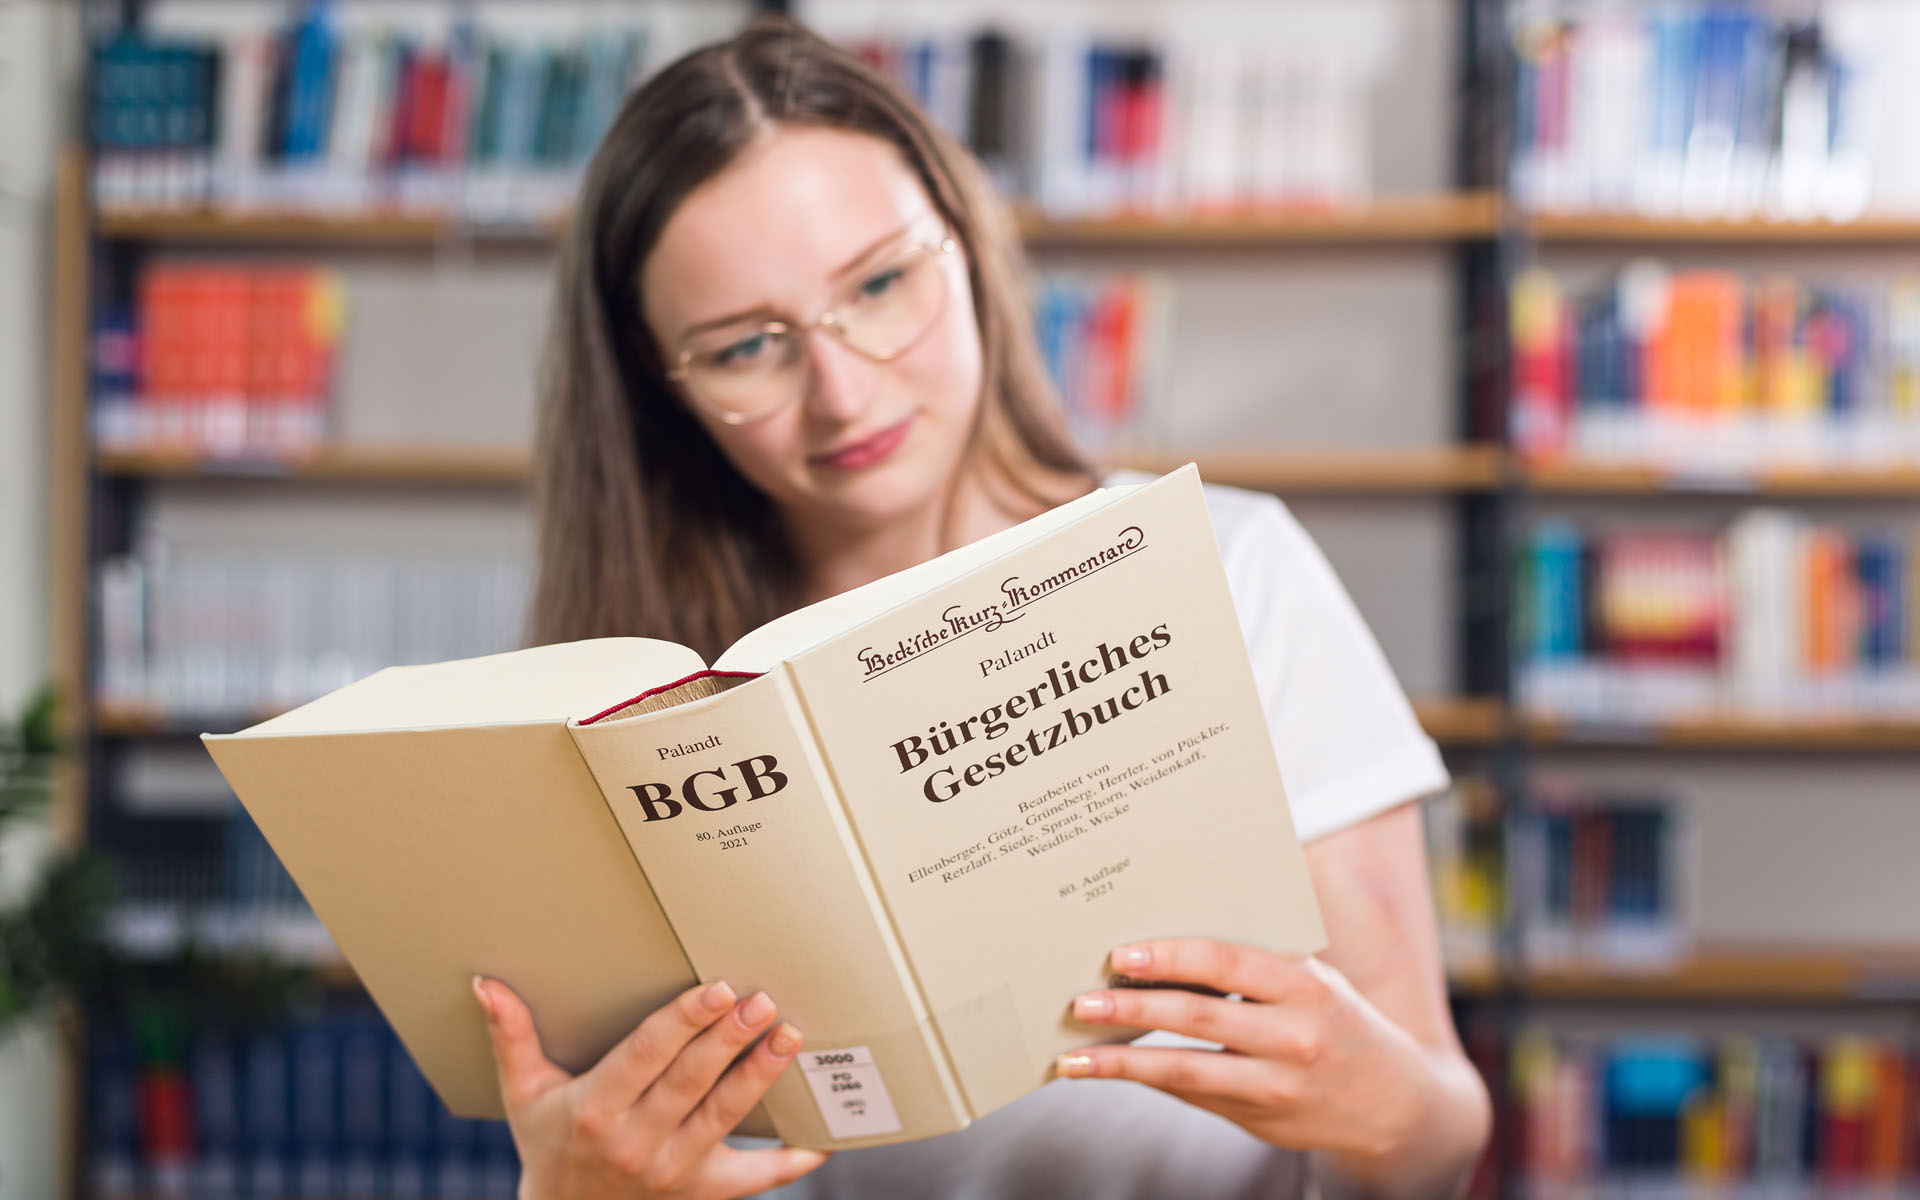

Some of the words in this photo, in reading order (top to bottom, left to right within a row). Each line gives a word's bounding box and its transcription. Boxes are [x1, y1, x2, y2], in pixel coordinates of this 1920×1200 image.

[978, 630, 1058, 678] Palandt
[889, 623, 1172, 774] Bürgerliches
[656, 734, 723, 760] Palandt
[922, 669, 1172, 803] Gesetzbuch
[625, 754, 788, 823] BGB
[908, 842, 985, 883] Ellenberger,
[987, 824, 1023, 845] Götz,
[1025, 789, 1097, 826] Grüneberg,
[1099, 762, 1149, 791] Herrler,
[1151, 749, 1175, 765] von
[1177, 722, 1230, 752] Pückler,
[1018, 777, 1083, 813] Bearbeitet
[1086, 763, 1110, 780] von
[695, 831, 715, 842] 80.
[717, 821, 763, 838] Auflage
[942, 850, 997, 883] Retzlaff,
[999, 833, 1039, 856] Siede,
[1041, 812, 1083, 836] Sprau,
[1084, 791, 1128, 814] Thorn,
[1129, 750, 1206, 792] Weidenkaff,
[1027, 825, 1089, 858] Weidlich,
[1089, 803, 1131, 828] Wicke
[719, 837, 749, 851] 2021
[1058, 883, 1078, 899] 80.
[1083, 858, 1131, 887] Auflage
[1084, 880, 1115, 903] 2021
